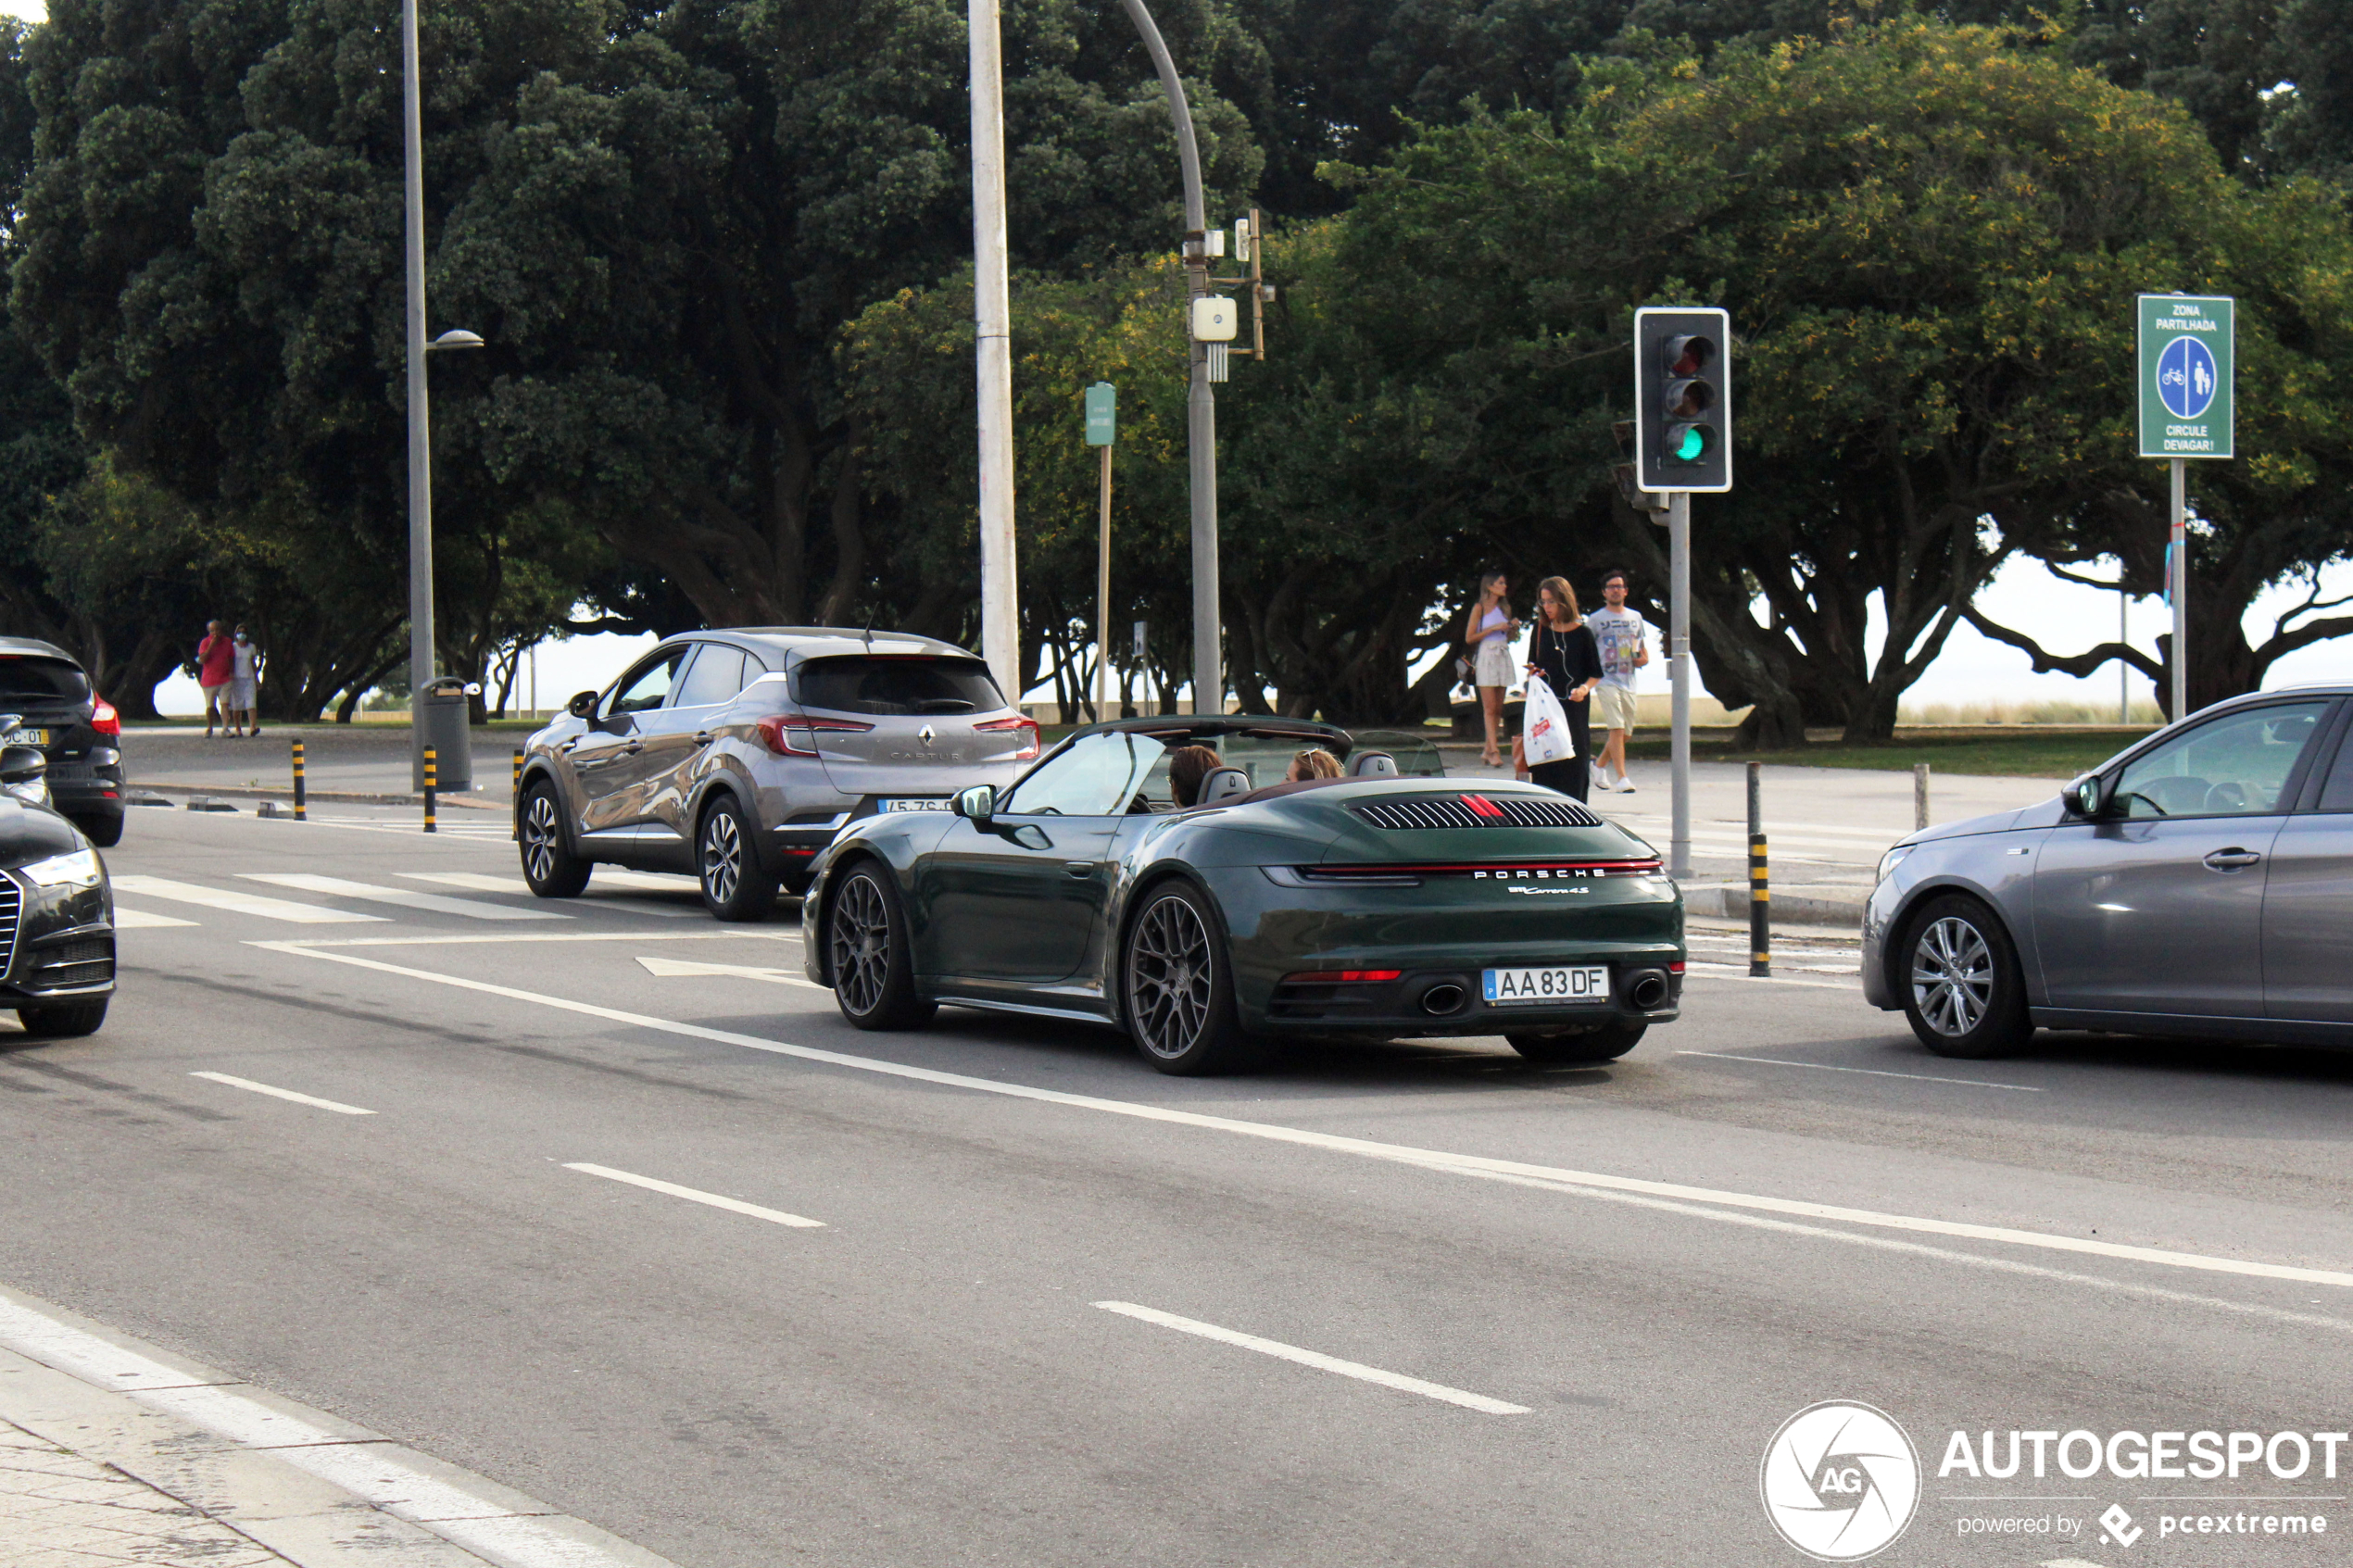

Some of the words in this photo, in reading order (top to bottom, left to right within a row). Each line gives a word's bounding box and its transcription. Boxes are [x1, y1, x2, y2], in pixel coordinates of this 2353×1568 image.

[2172, 305, 2200, 316] ZONA
[2156, 319, 2217, 331] PARTILHADA
[2166, 425, 2208, 436] CIRCULE
[890, 752, 960, 760] CAPTUR
[1474, 869, 1605, 879] PORSCHE
